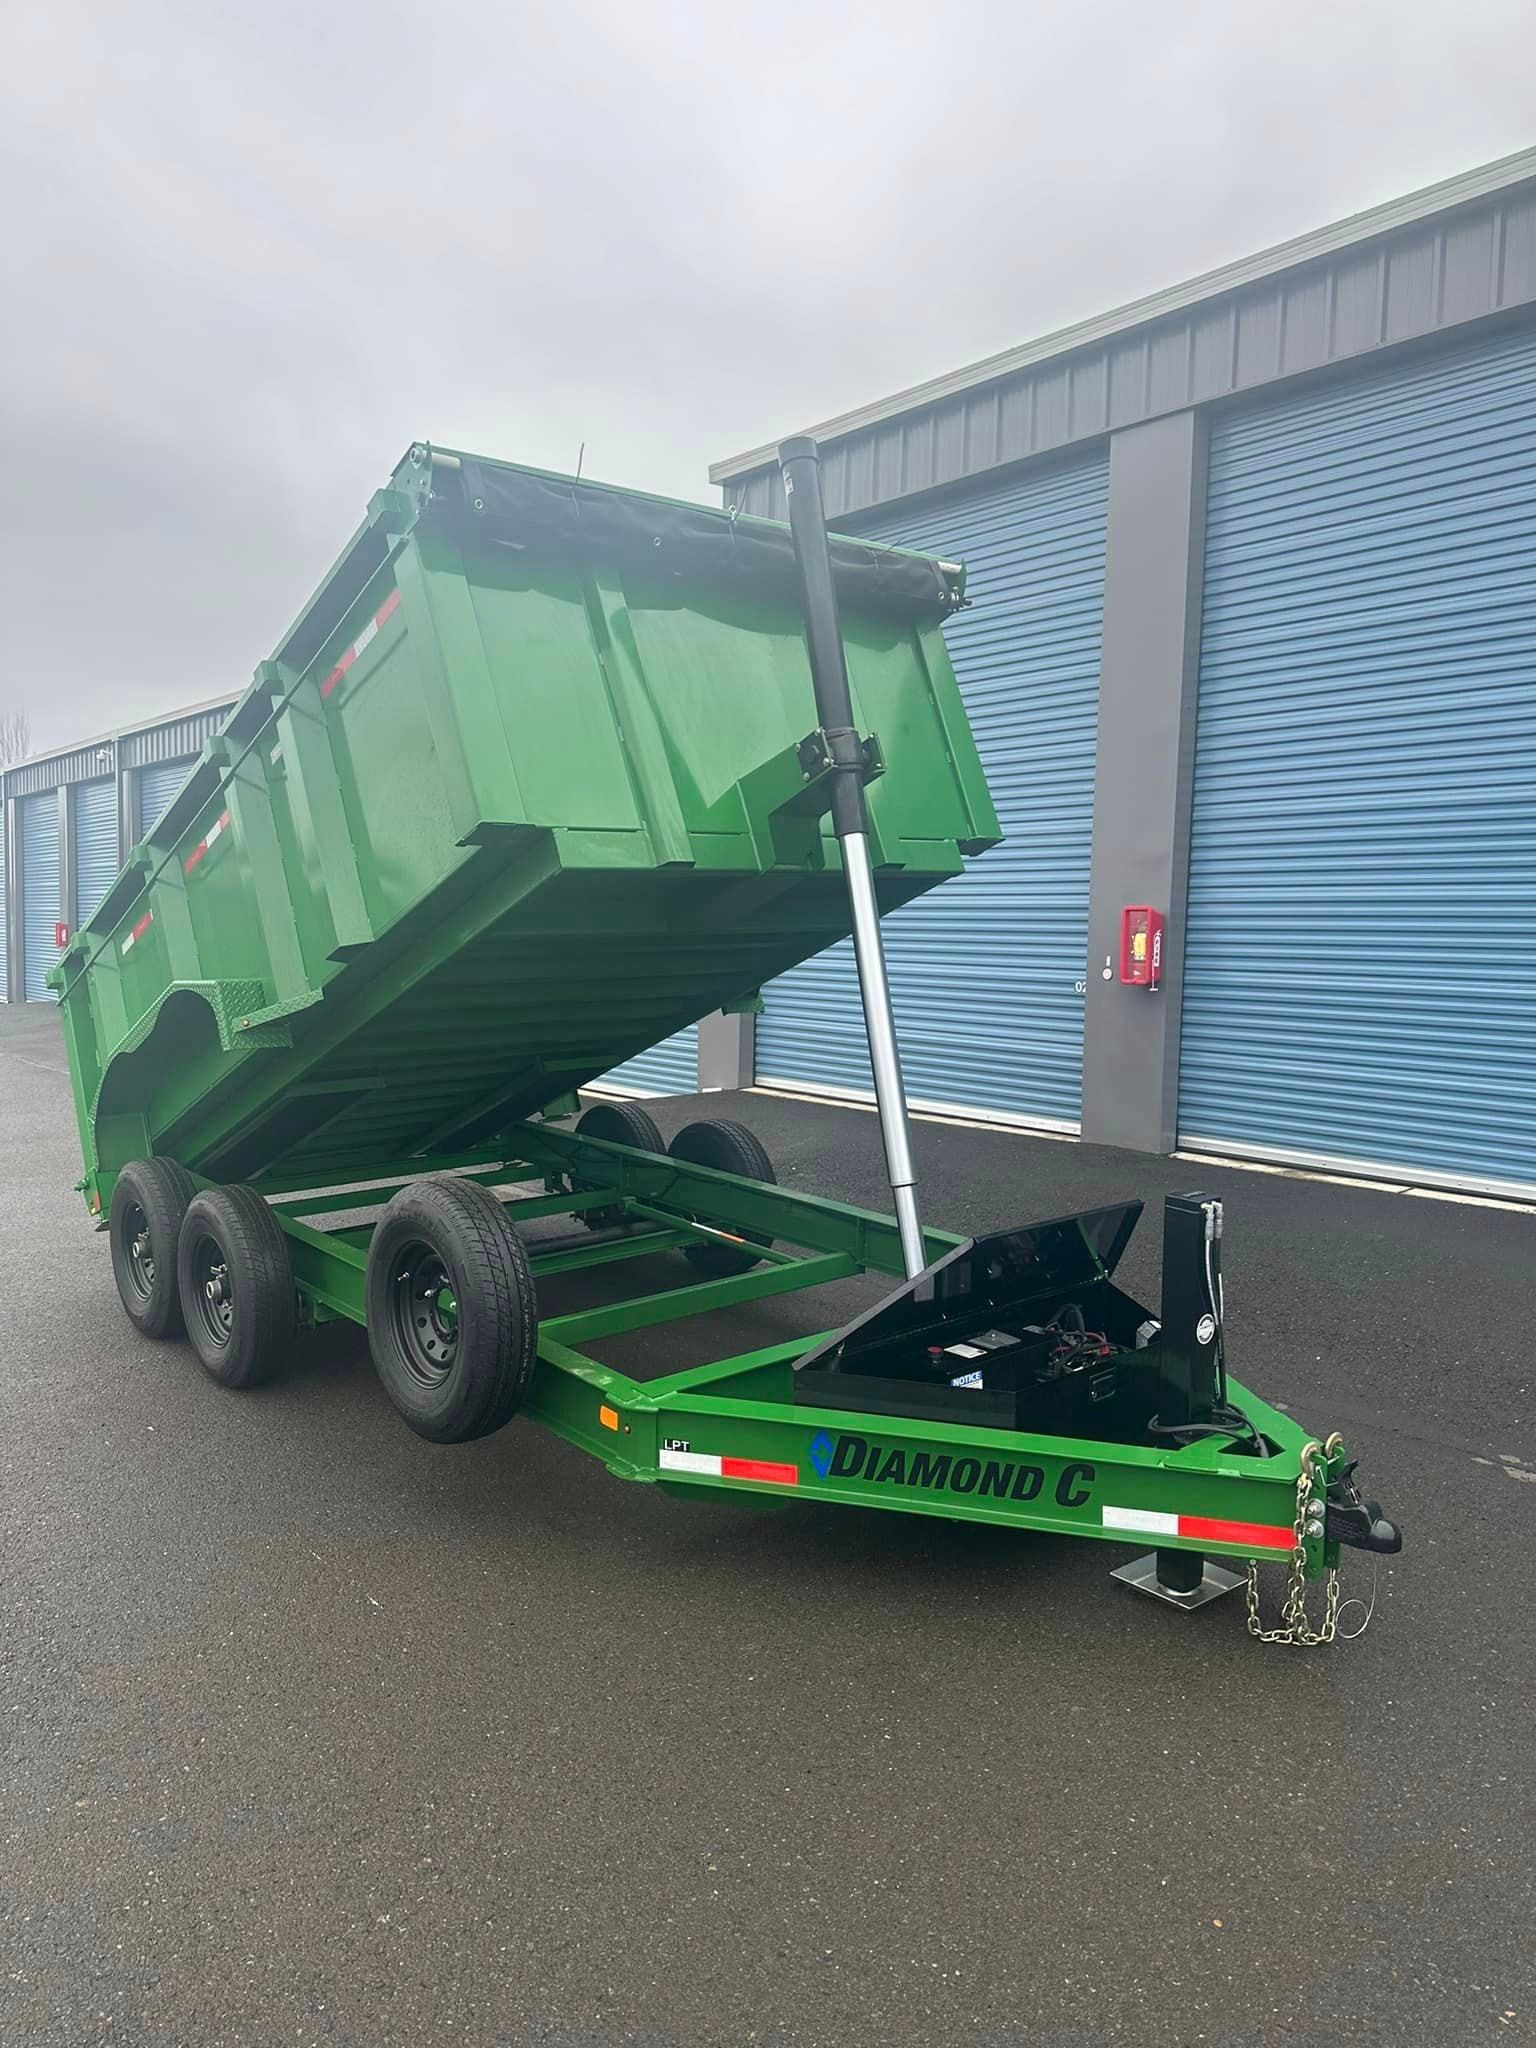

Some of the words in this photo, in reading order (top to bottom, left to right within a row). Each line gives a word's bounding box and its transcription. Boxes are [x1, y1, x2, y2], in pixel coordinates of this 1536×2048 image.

[951, 1370, 982, 1387] NOTICE
[664, 1438, 690, 1452] LPT
[828, 1435, 1045, 1501] DIAMOND
[1055, 1463, 1096, 1508] C
